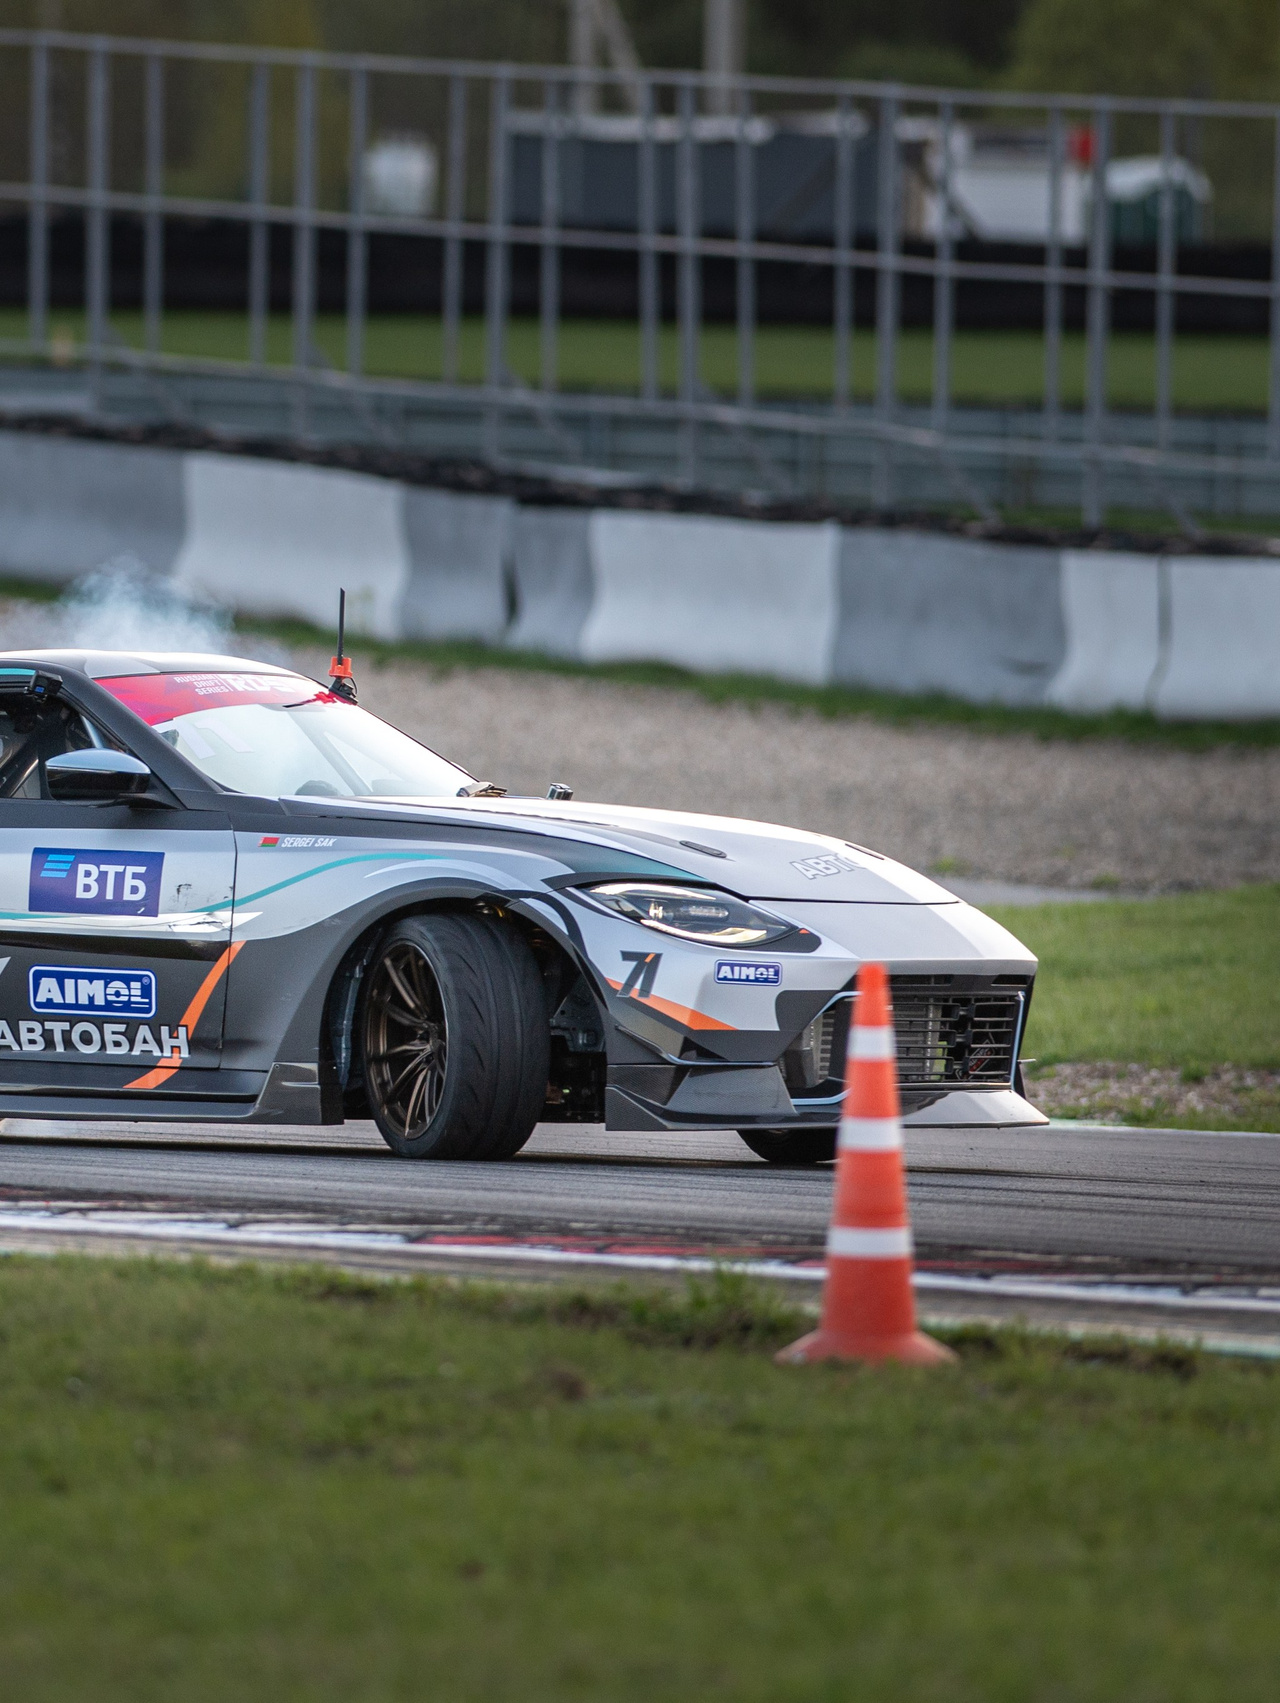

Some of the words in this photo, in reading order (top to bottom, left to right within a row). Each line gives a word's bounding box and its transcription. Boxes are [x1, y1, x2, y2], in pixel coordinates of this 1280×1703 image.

[174, 674, 217, 684] RUSSIAN
[193, 680, 221, 688] DRIFT
[195, 685, 231, 696] SERIES
[281, 837, 316, 848] SERGEI
[314, 838, 337, 847] SAK
[75, 864, 147, 902] ВТБ
[616, 950, 664, 998] 71
[718, 965, 778, 981] AIMOL
[35, 977, 150, 1008] AIMOL
